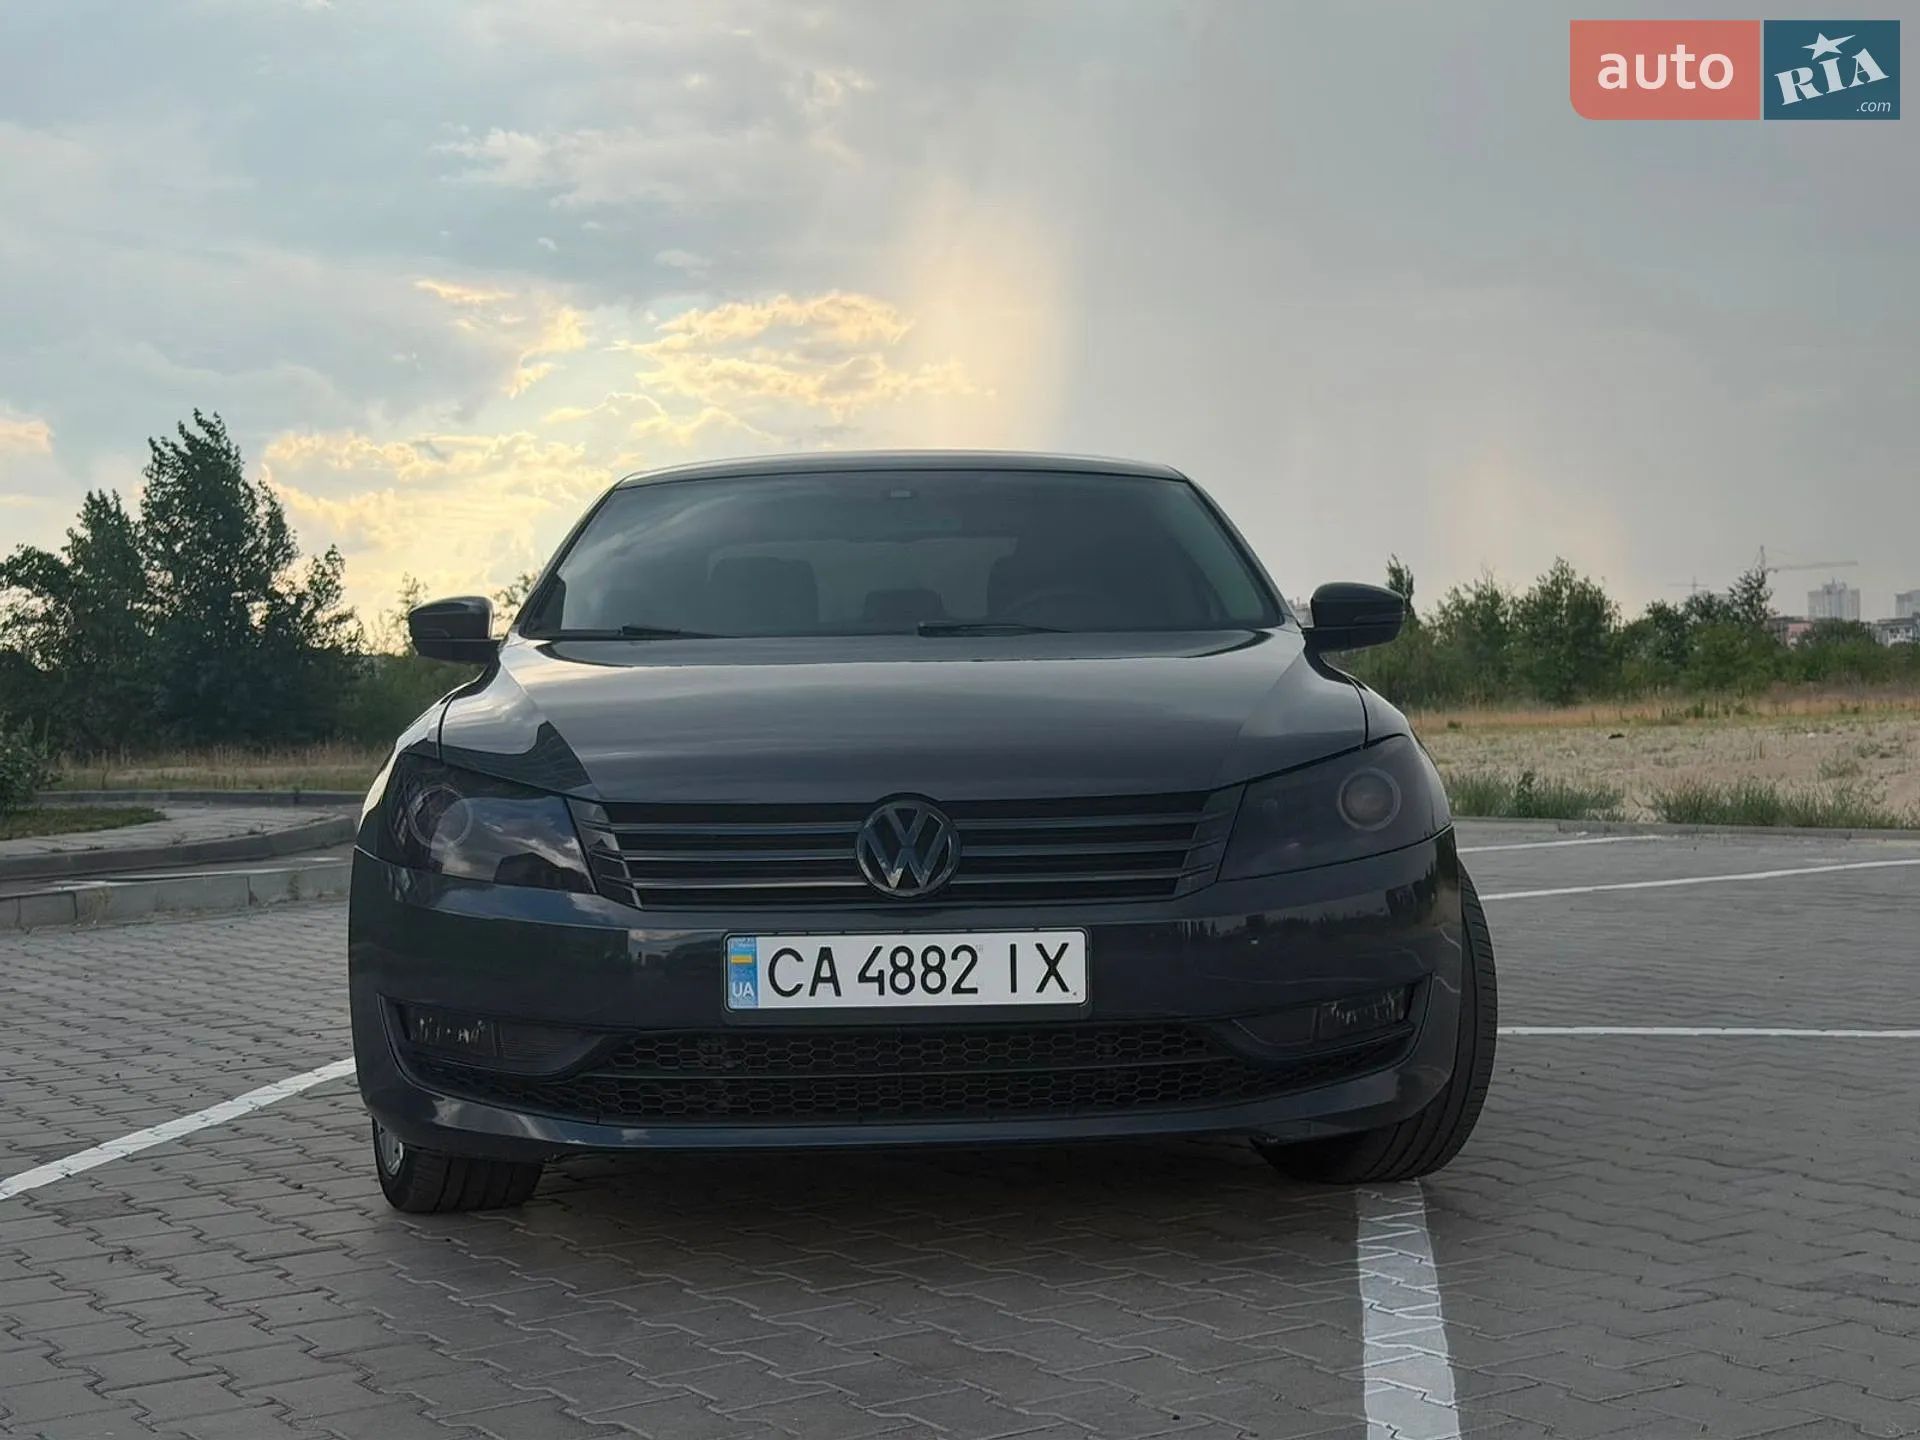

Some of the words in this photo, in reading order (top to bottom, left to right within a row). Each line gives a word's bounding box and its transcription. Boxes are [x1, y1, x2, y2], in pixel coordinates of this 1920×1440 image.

[767, 946, 842, 997] CA
[857, 944, 979, 997] 4882
[1009, 942, 1070, 994] IX
[732, 981, 755, 998] UA
